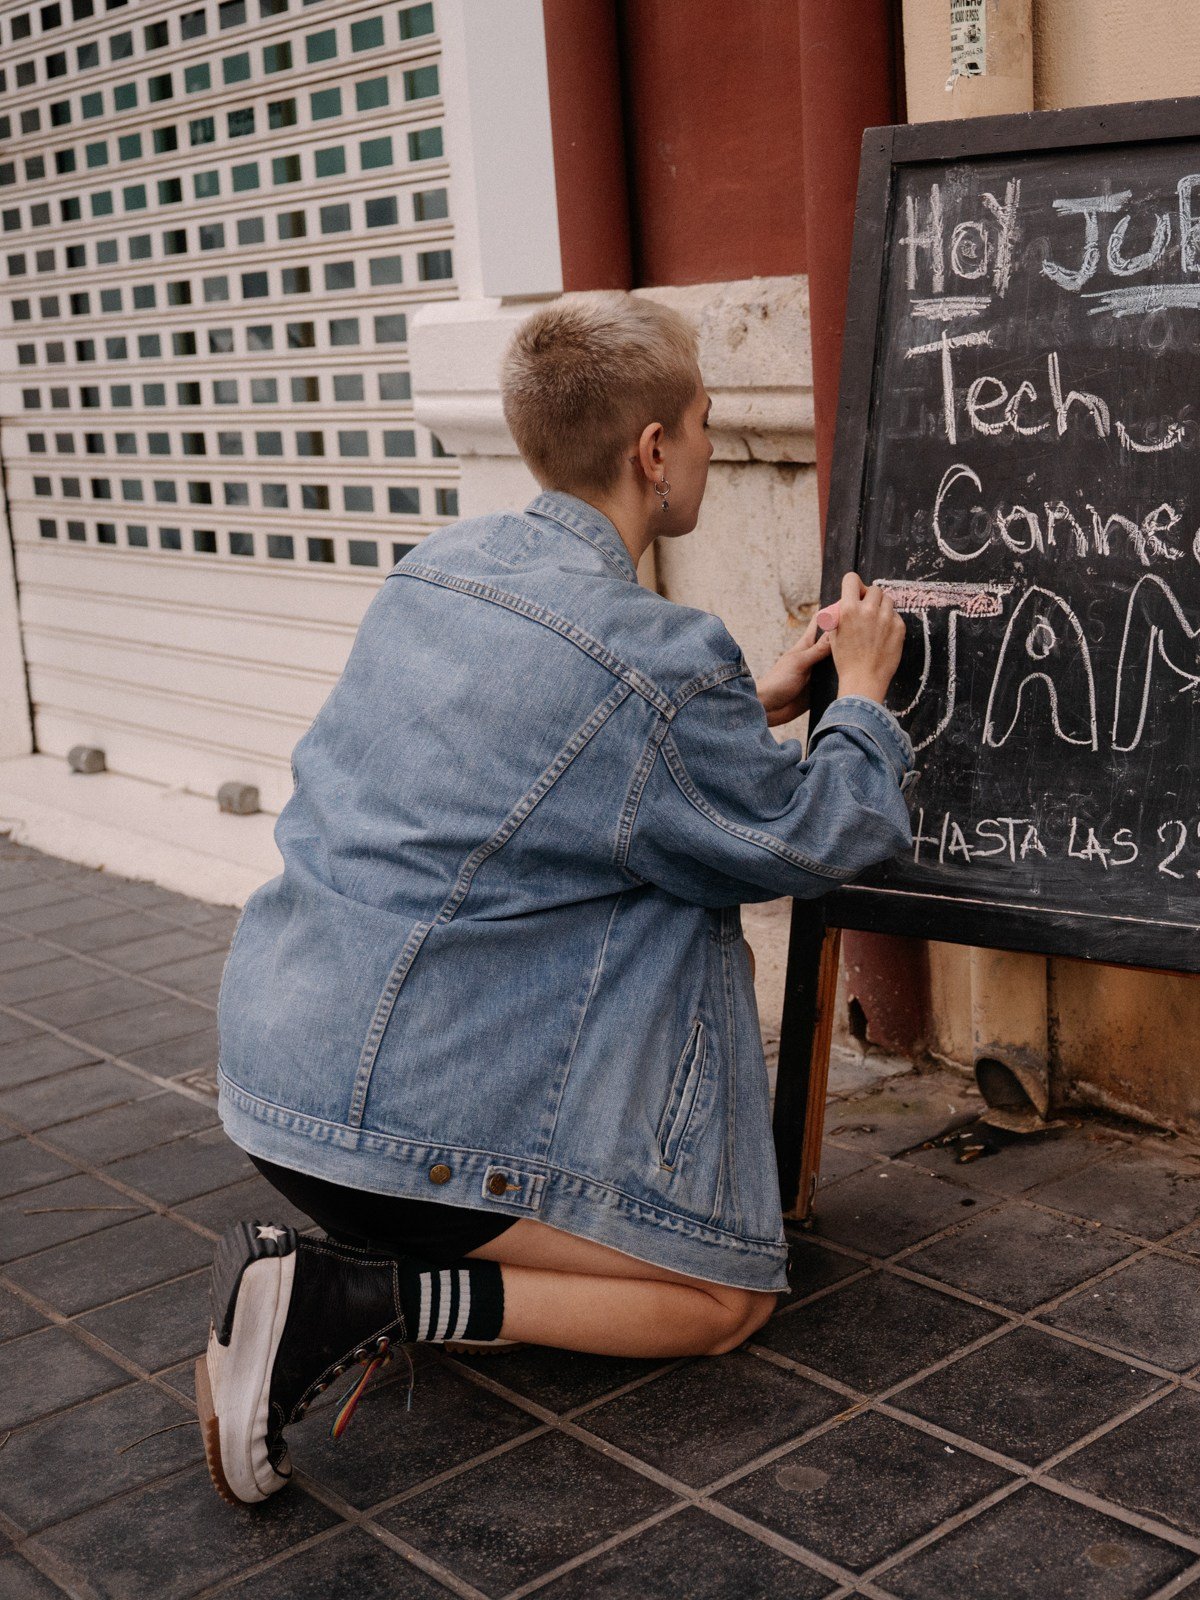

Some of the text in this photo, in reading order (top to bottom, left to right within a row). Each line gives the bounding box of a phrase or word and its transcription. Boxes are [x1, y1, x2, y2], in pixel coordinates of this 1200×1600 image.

[904, 329, 1112, 446] Tech
[912, 808, 1048, 865] HASTA
[1066, 816, 1139, 871] LAS
